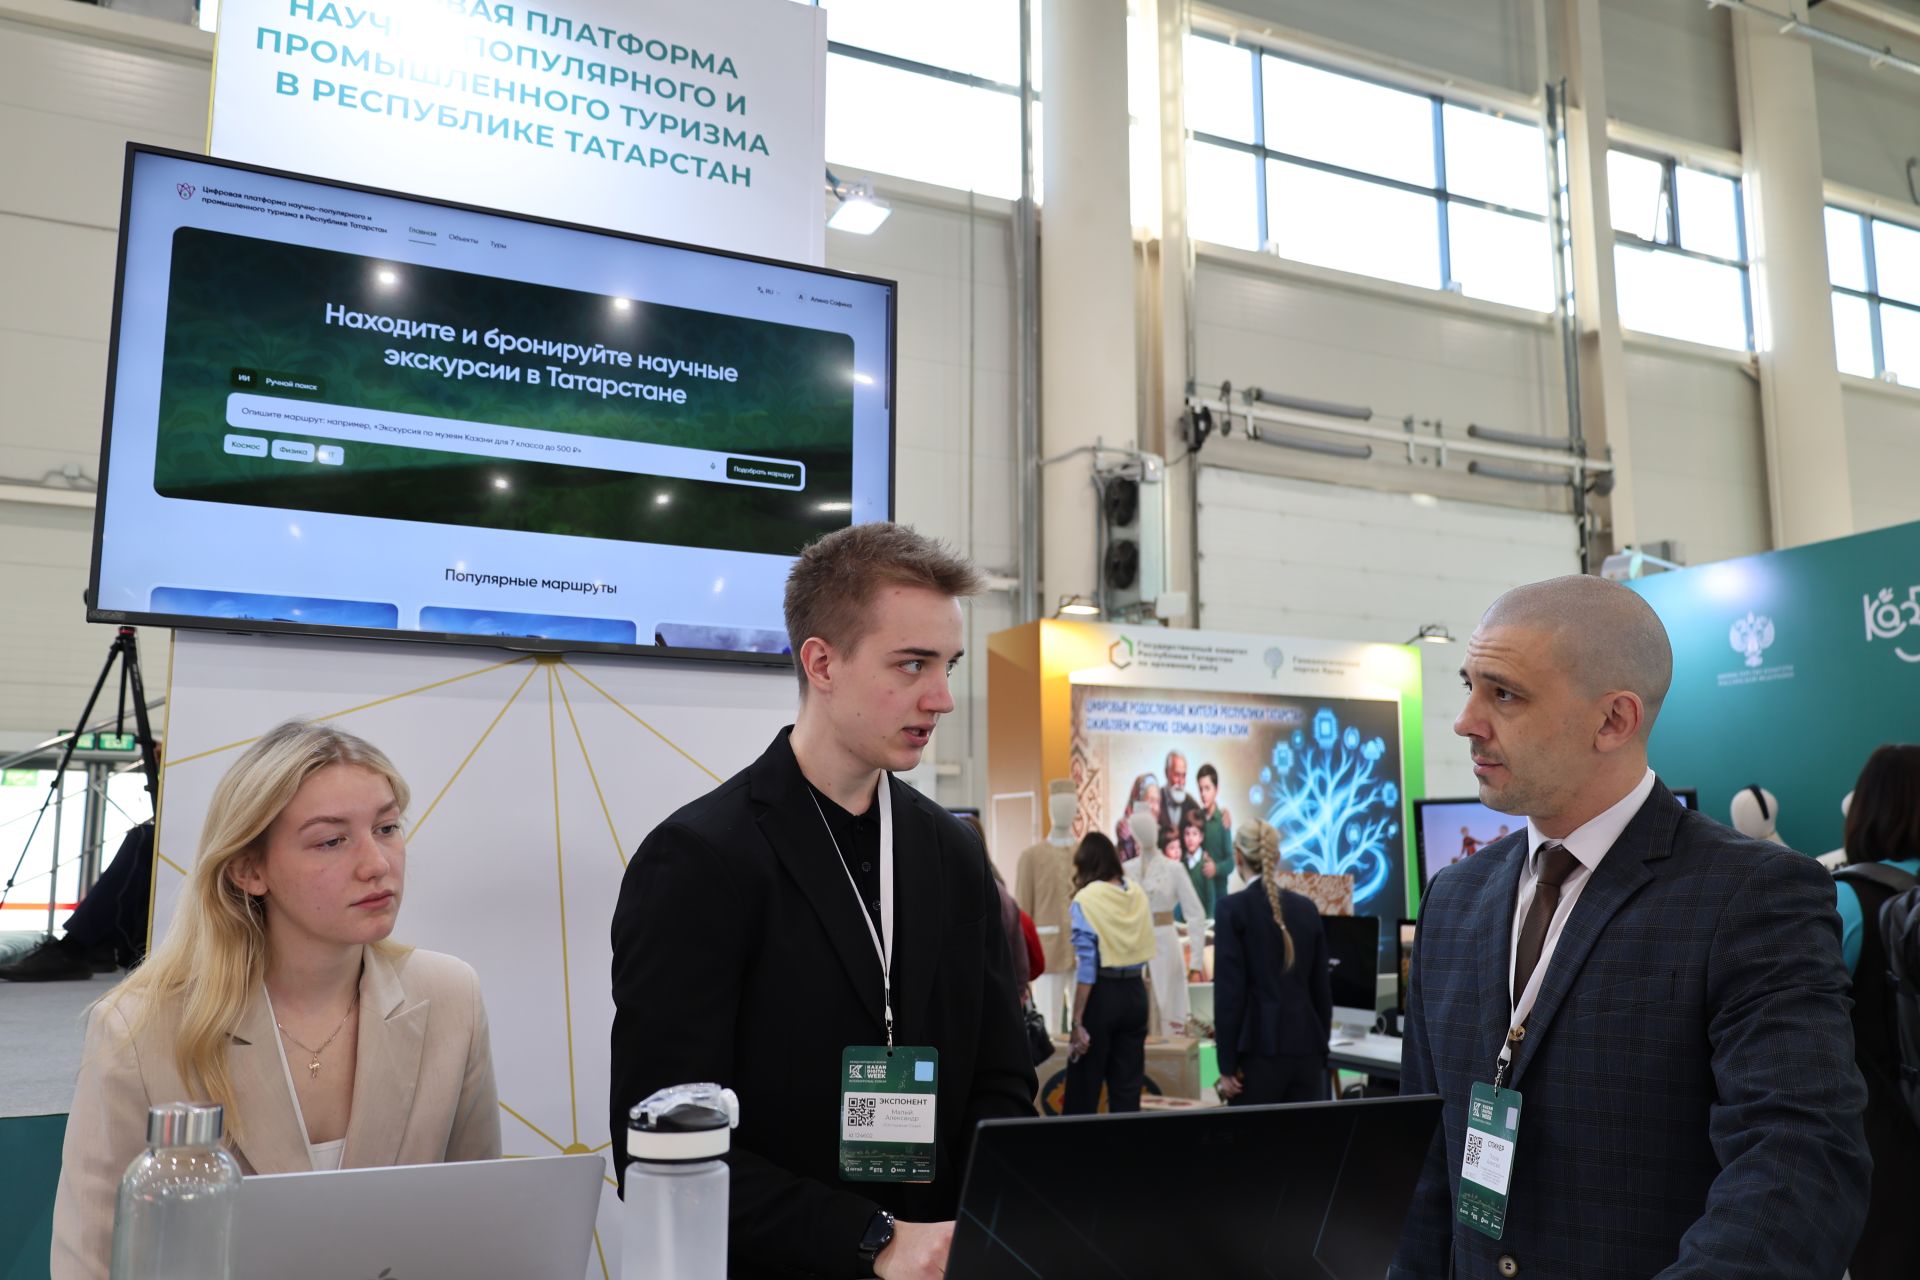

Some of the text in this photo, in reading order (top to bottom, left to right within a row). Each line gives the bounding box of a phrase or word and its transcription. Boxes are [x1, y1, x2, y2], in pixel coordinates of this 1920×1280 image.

[527, 10, 739, 79] ПЛАТФОРМА
[256, 27, 770, 156] ПРОМЫШЛЕННОГО ТУРИЗМА
[726, 93, 748, 116] И
[276, 71, 752, 188] В РЕСПУБЛИКЕ ТАТАРСТАН
[201, 197, 266, 213] промышленного
[267, 207, 298, 219] туризма
[305, 214, 348, 227] Республике
[349, 221, 388, 234] Татарстан
[202, 185, 242, 199] Цифровая
[244, 193, 287, 207] платформа
[288, 202, 366, 221] научно-популярного
[325, 302, 739, 383] Находите и бронируйте научные
[265, 377, 319, 391] Ручной поиск
[383, 348, 687, 405] экскурсии в Татарстане
[231, 441, 261, 451] Космос
[241, 407, 282, 419] Опишите
[283, 413, 326, 425] маршрут:
[327, 418, 372, 431] например,
[422, 429, 434, 438] по
[434, 431, 463, 442] музеям
[464, 434, 494, 445] Казани
[494, 438, 509, 447] для
[516, 441, 544, 450] класса
[544, 444, 555, 452] до
[556, 445, 571, 453] 500
[279, 445, 308, 456] Физика
[733, 465, 796, 480] Подобрать маршрут
[445, 568, 618, 596] Популярные маршруты
[879, 1098, 928, 1106] ЭКСПОНЕНТ
